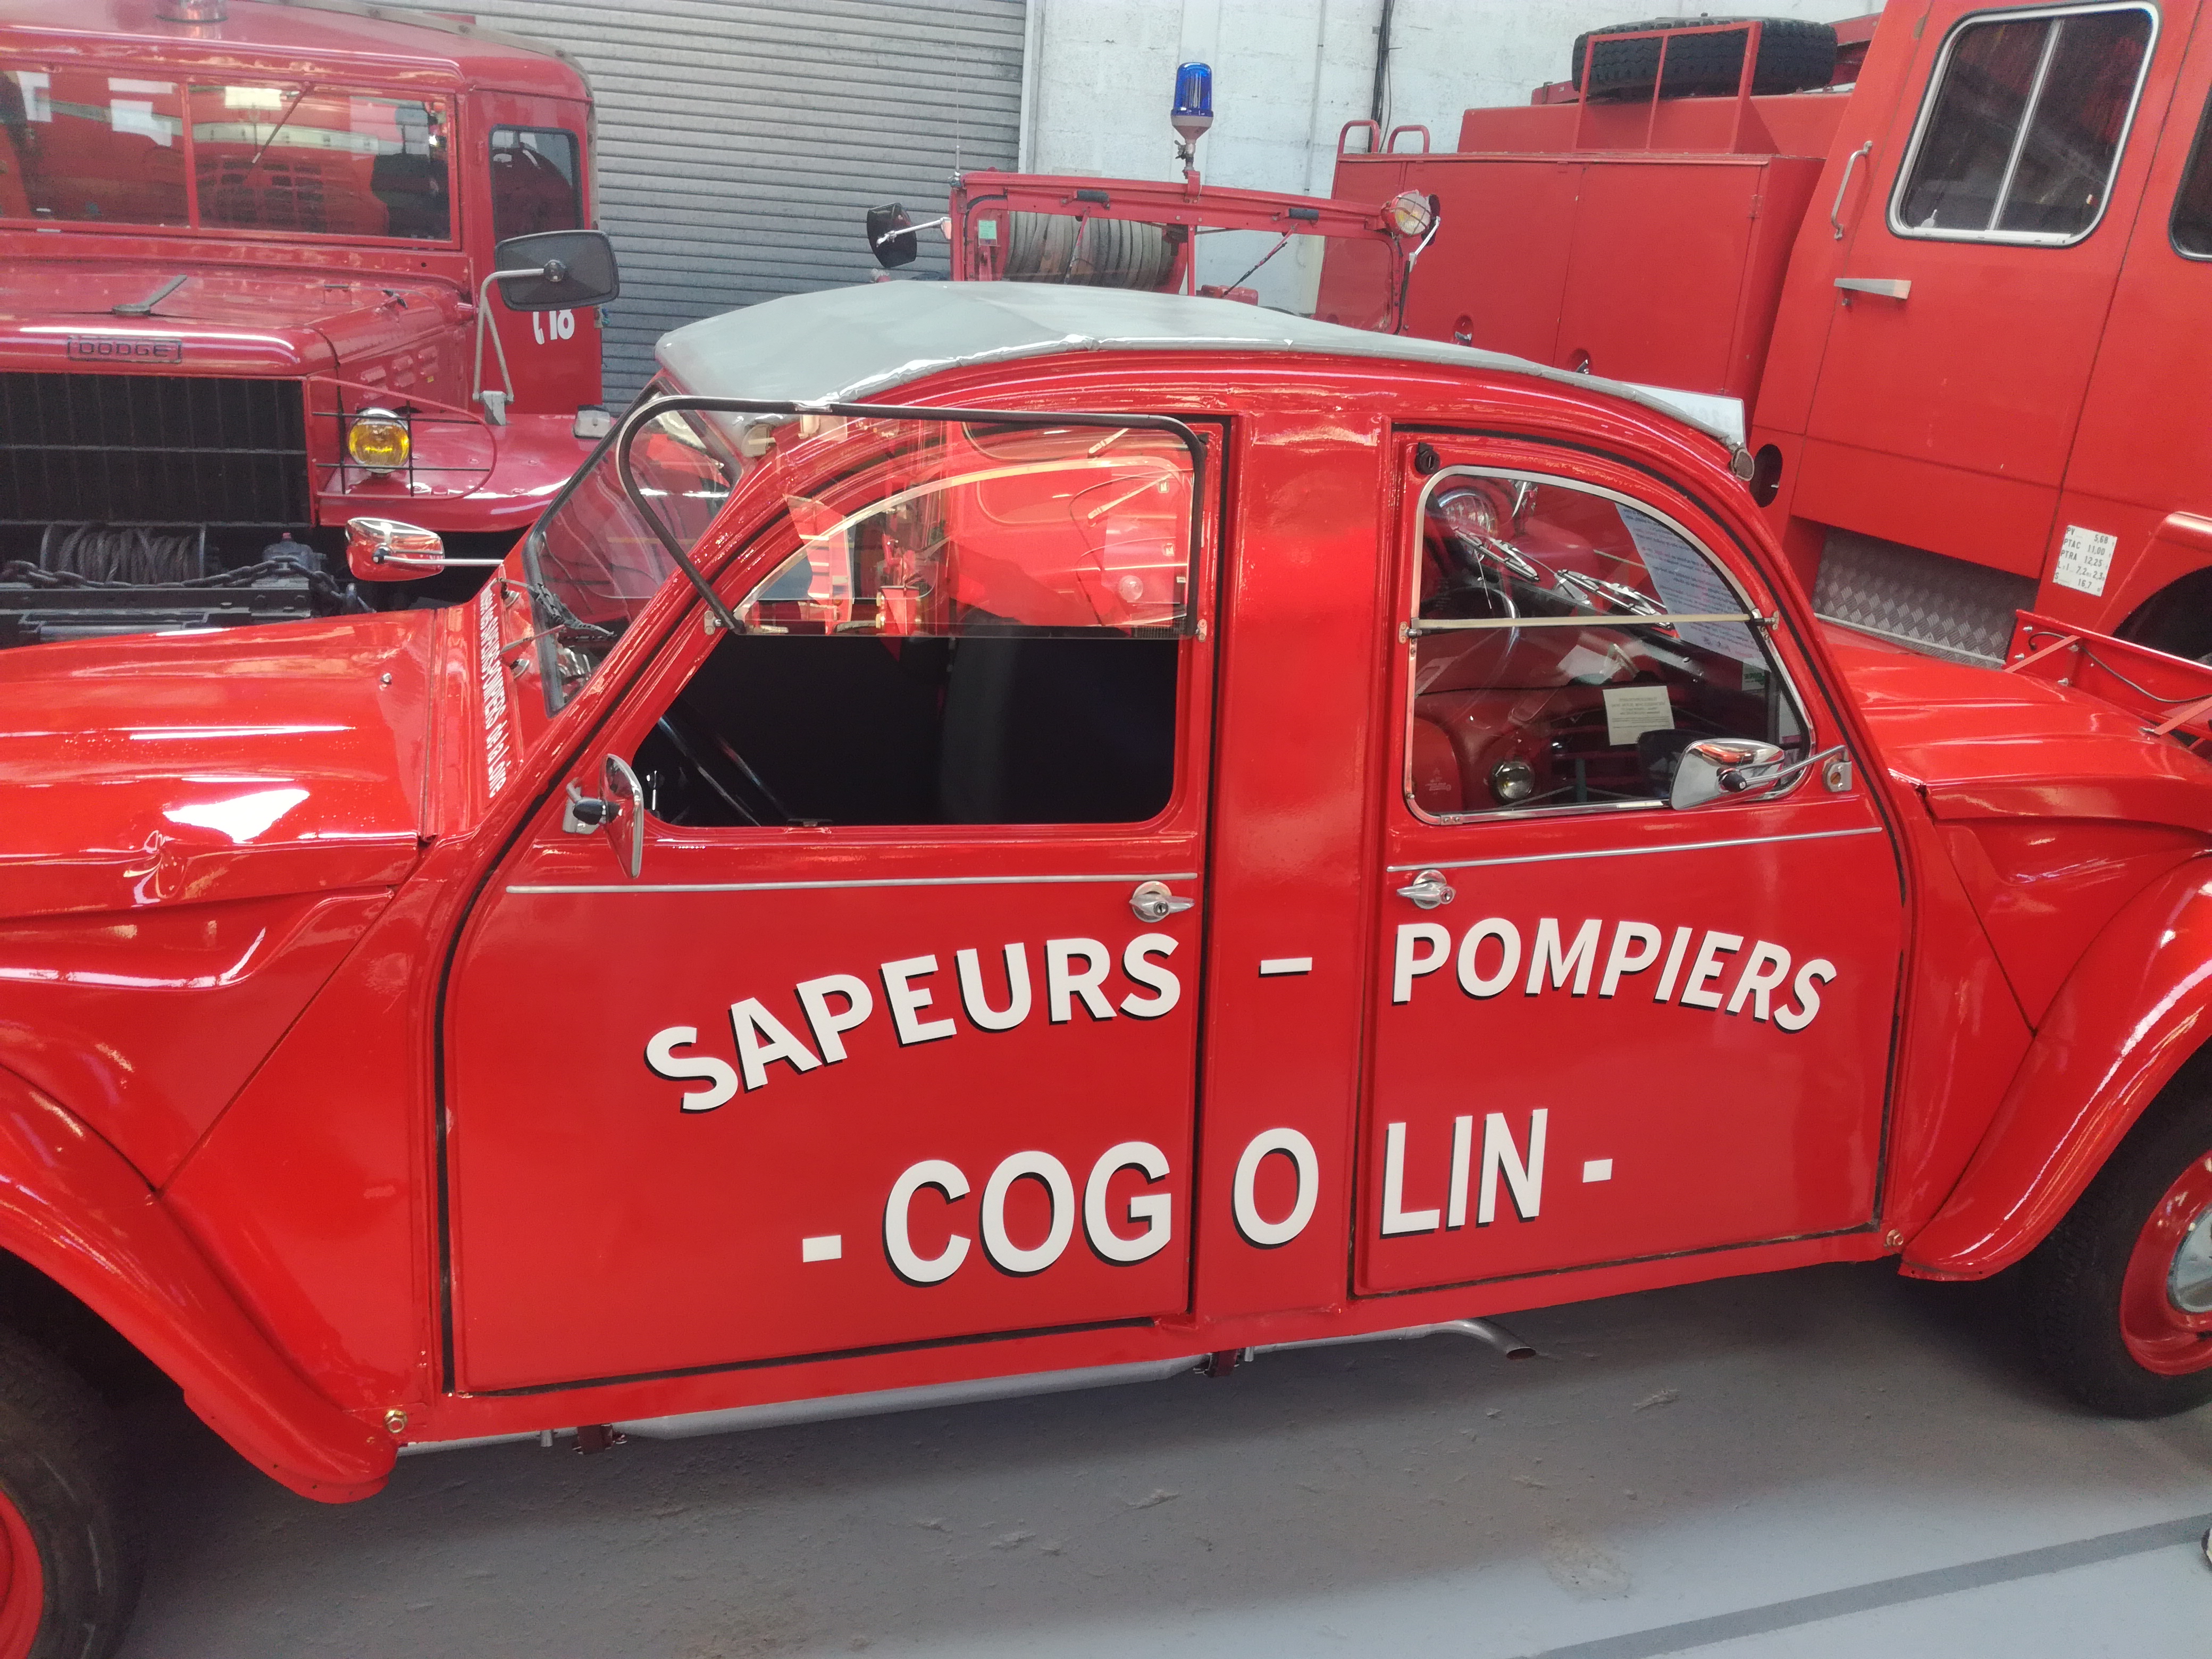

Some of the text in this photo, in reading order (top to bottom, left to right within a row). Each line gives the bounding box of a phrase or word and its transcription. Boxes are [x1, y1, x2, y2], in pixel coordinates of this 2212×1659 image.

[79, 342, 172, 358] DODGE
[2067, 527, 2075, 535] PV
[2060, 549, 2077, 561] PTRA
[2064, 538, 2081, 549] PTAC
[487, 719, 508, 750] de
[487, 732, 509, 765] la
[489, 745, 512, 798] Loire
[645, 932, 1182, 1112] SAPEURS
[1392, 917, 1837, 1032] POMPIERS
